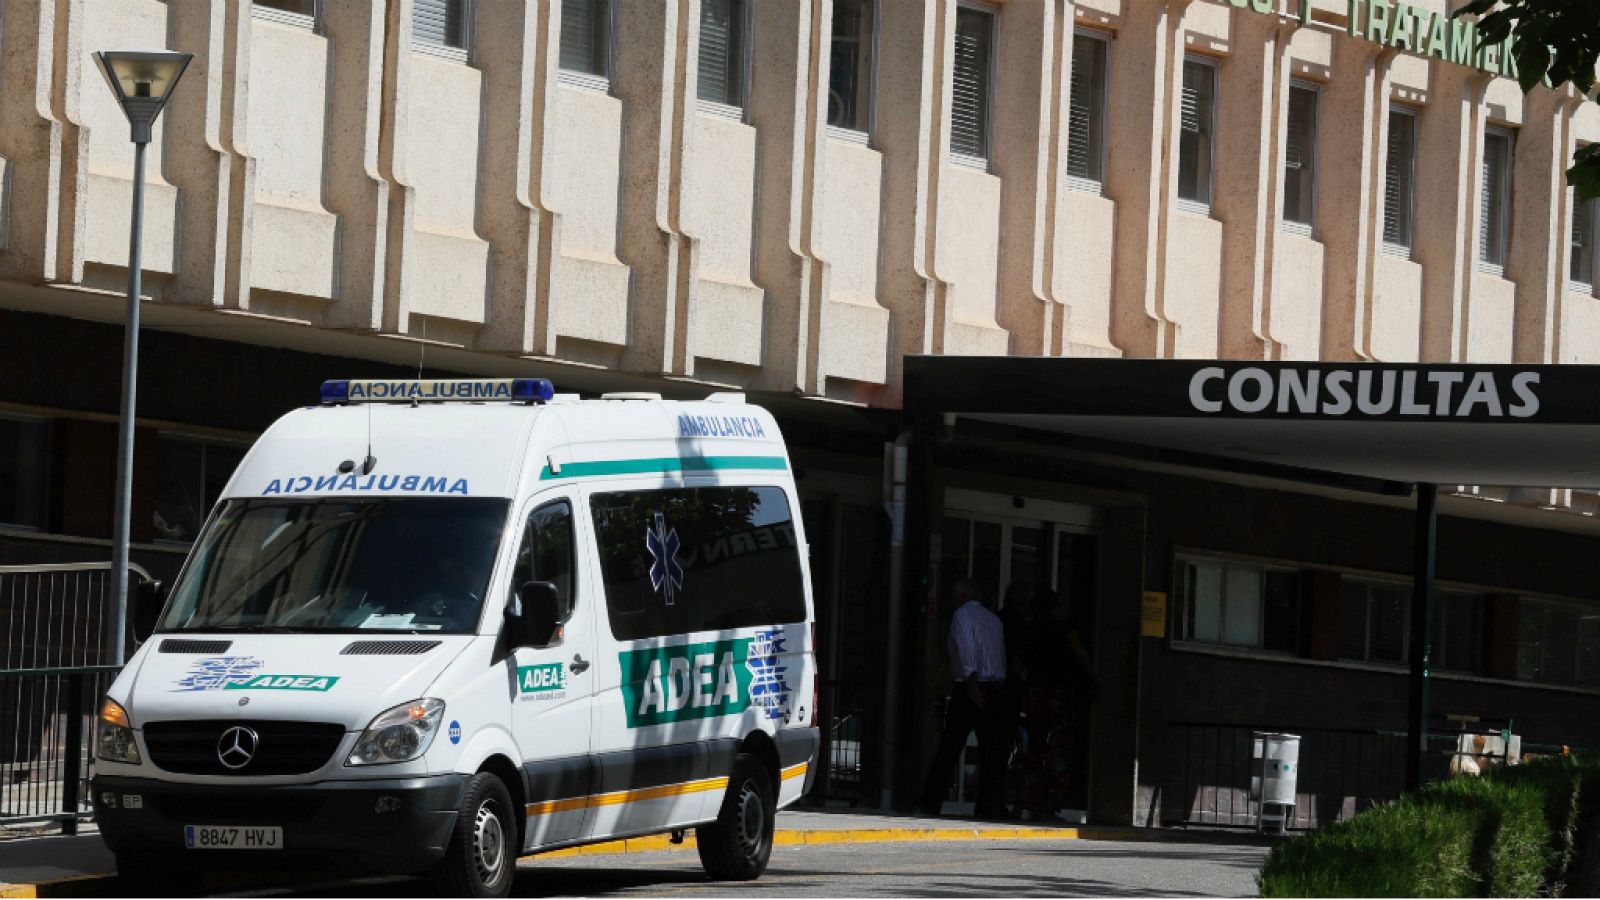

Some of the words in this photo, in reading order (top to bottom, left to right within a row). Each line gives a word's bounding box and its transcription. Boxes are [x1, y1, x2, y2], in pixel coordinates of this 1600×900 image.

[1189, 367, 1540, 418] CONSULTAS
[678, 414, 766, 438] AMBULANCIA
[253, 676, 330, 689] ADEA
[523, 667, 559, 689] ADEA
[639, 651, 738, 715] ADEA
[200, 829, 238, 846] 8847
[245, 829, 276, 846] HVJ
